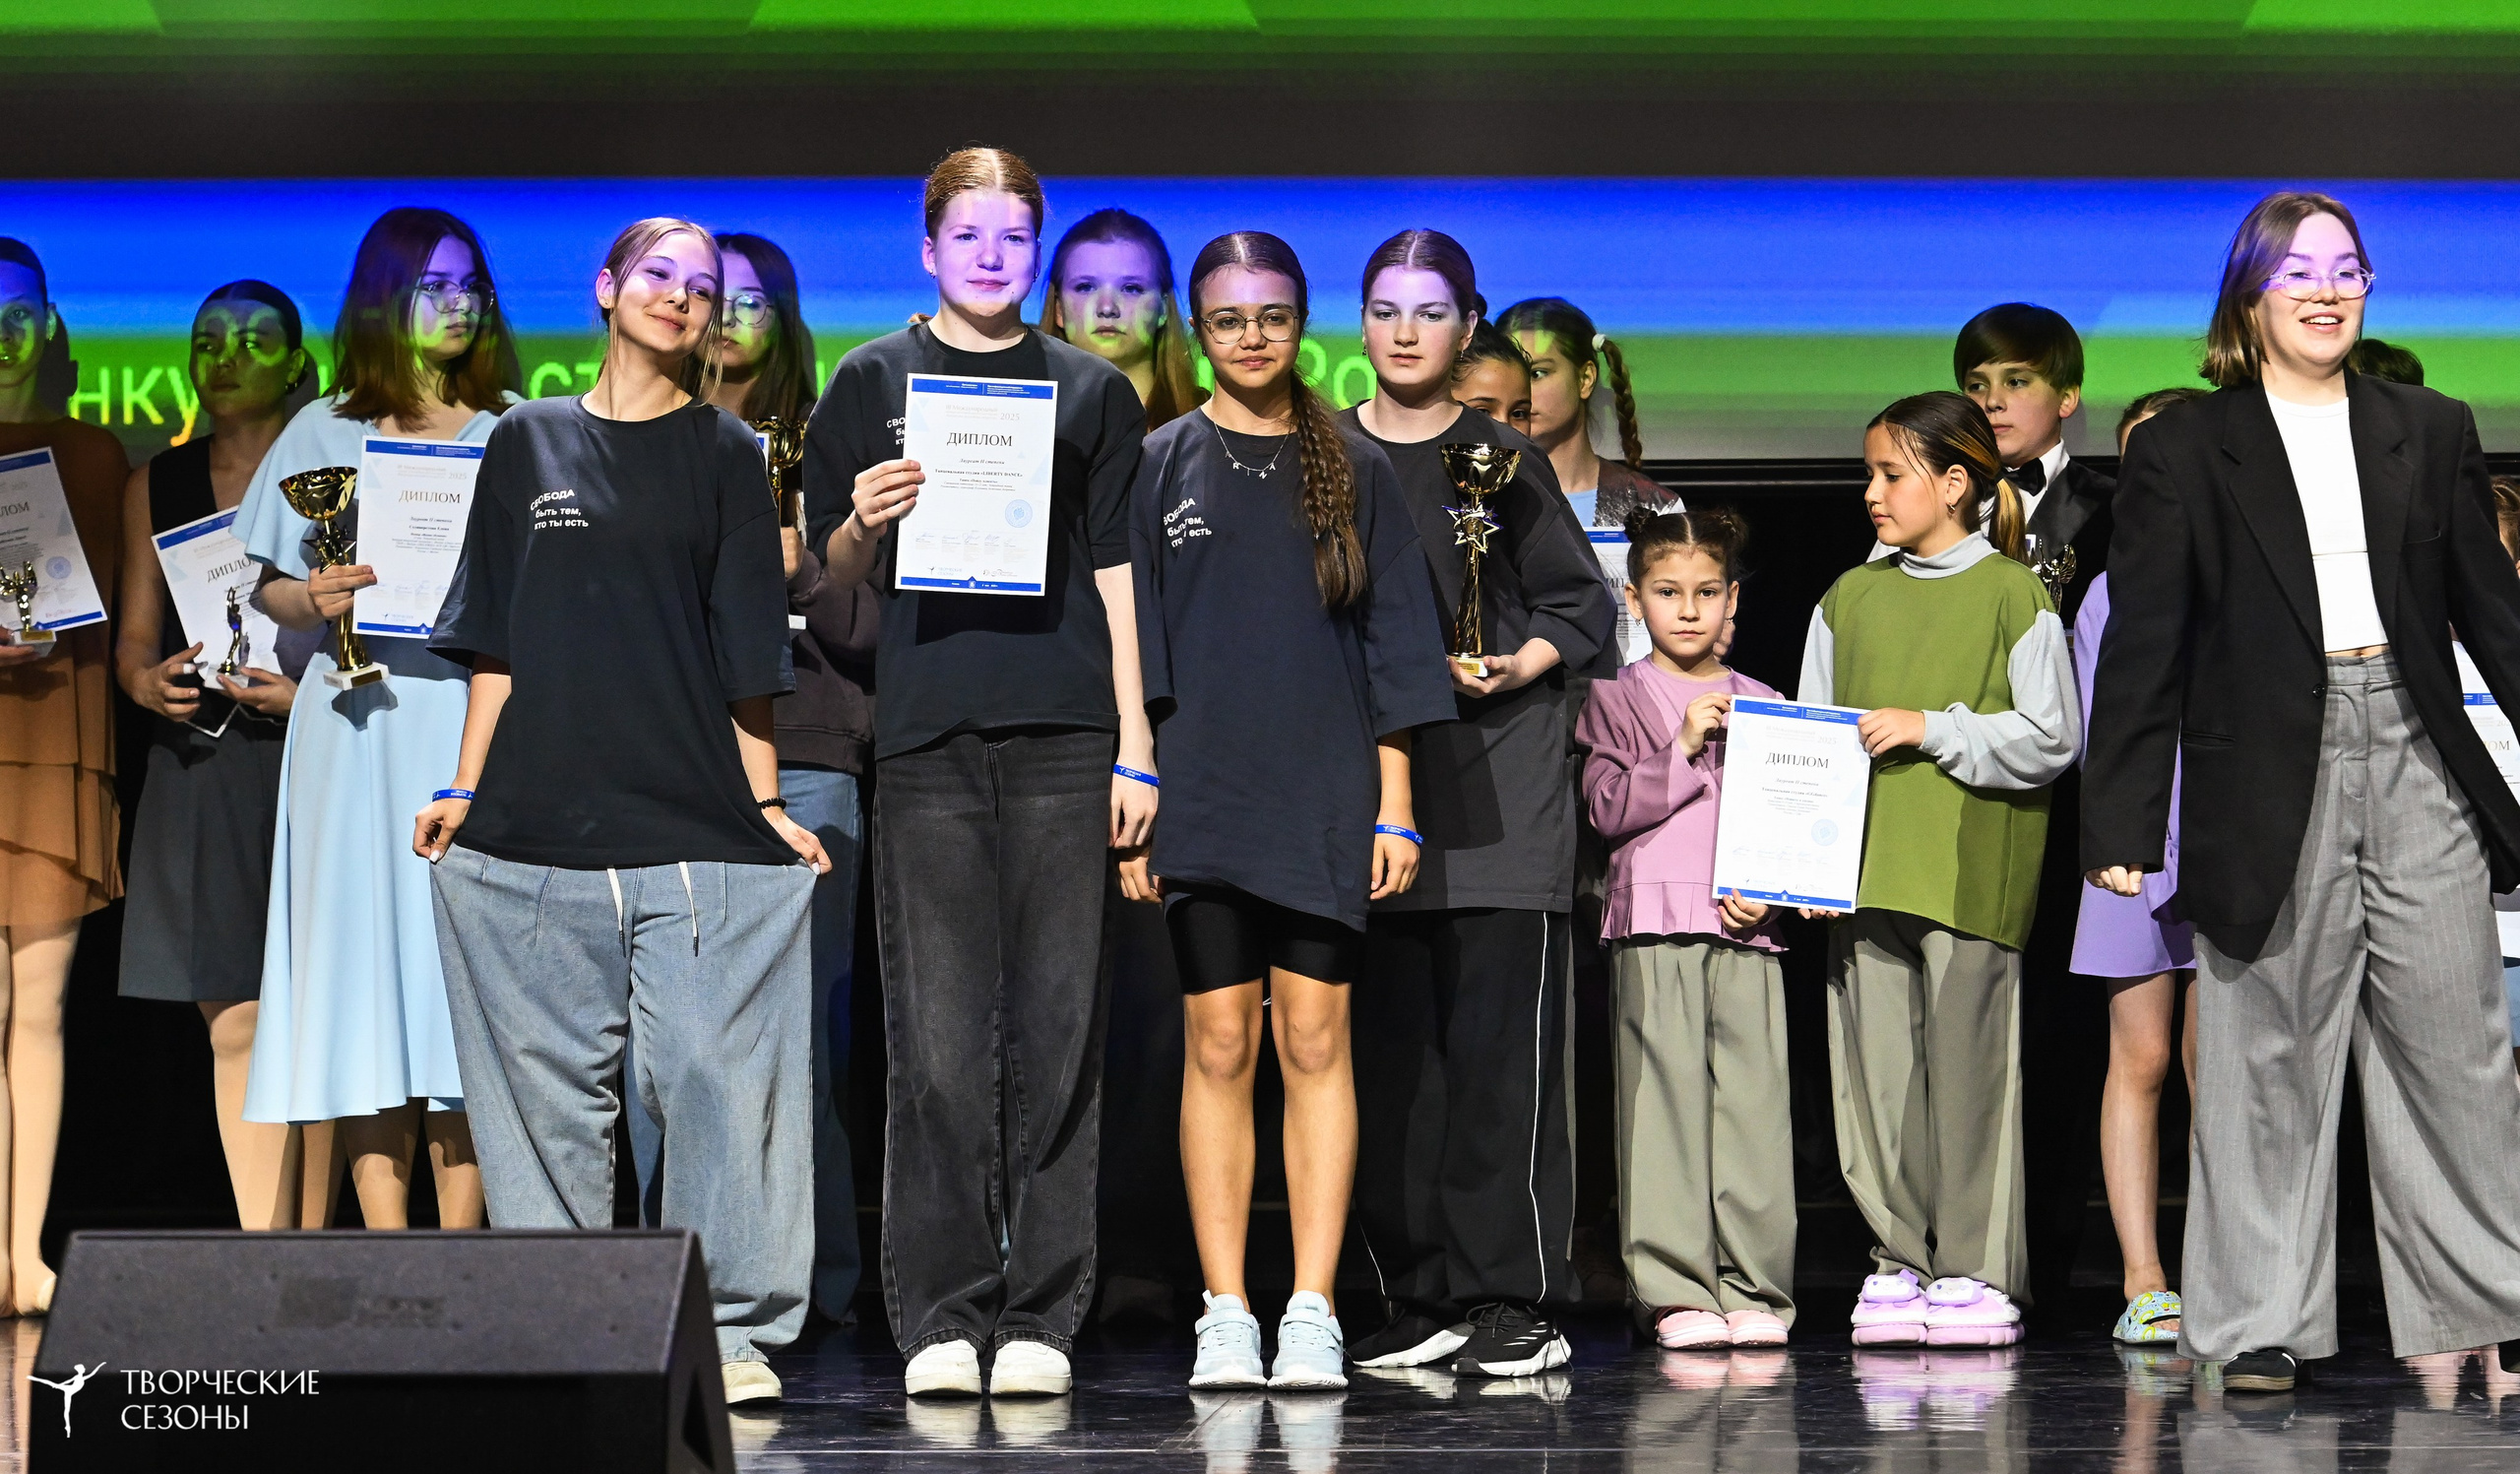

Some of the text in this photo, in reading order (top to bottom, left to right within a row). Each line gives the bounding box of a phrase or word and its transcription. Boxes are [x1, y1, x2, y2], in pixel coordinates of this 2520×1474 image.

[1000, 413, 1021, 421] 2025
[946, 432, 1013, 447] ДИПЛОМ
[398, 489, 462, 504] ДИПЛОМ
[535, 507, 582, 519] быть тем,
[548, 519, 563, 528] ты
[564, 519, 590, 528] есть
[1188, 528, 1213, 538] есть
[207, 557, 256, 584] ДИПЛО
[1765, 751, 1830, 769] ДИПЛОМ
